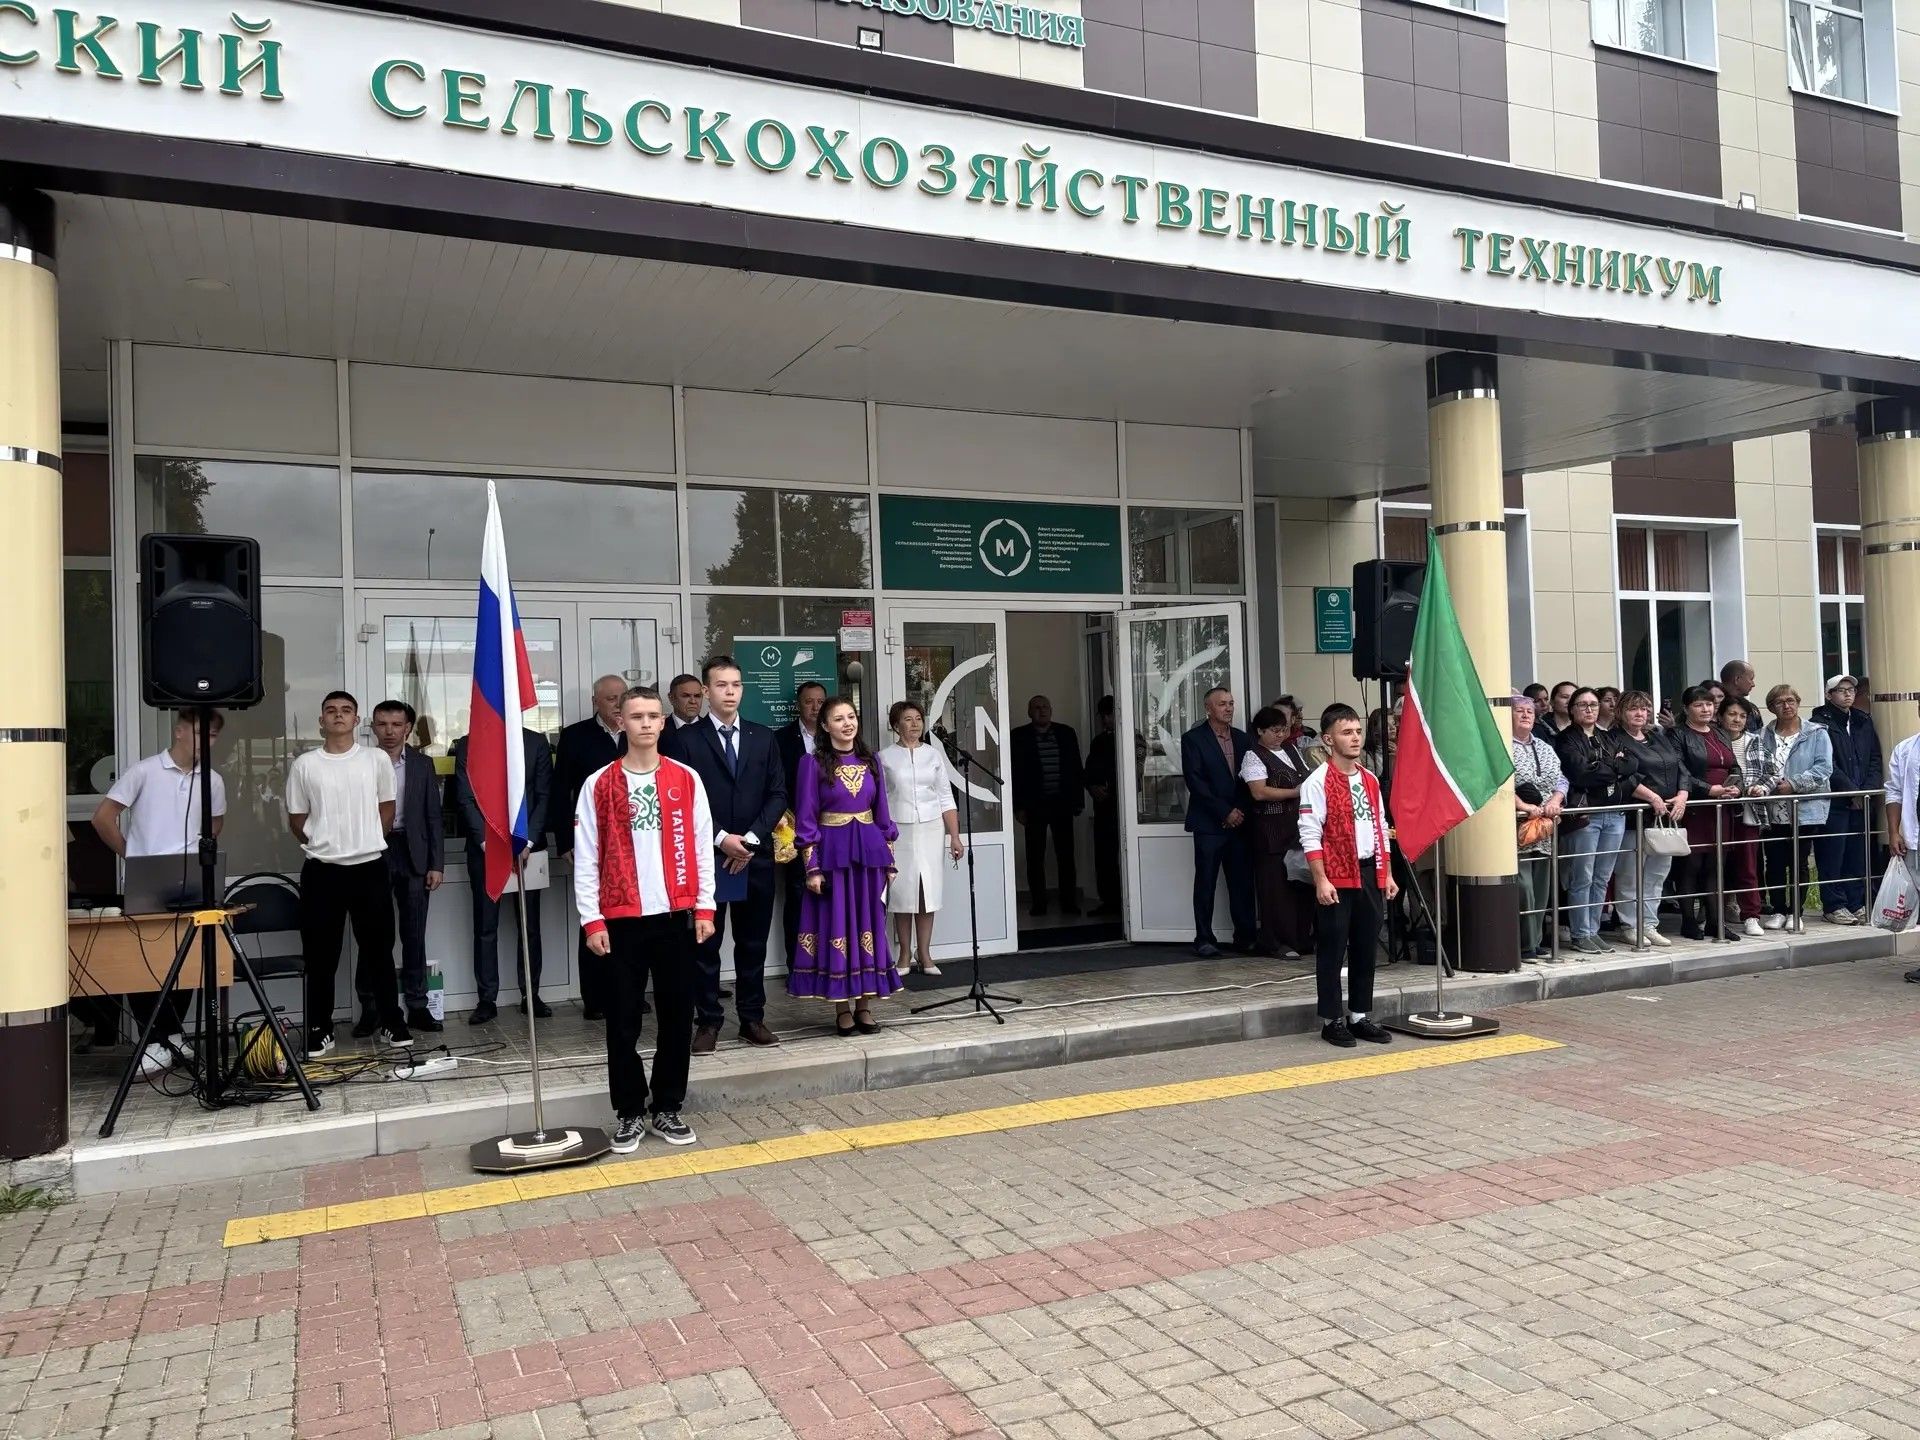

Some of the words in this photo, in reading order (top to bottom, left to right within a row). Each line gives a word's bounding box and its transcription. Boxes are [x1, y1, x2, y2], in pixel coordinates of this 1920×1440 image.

[0, 0, 285, 100] СКИЙ
[370, 58, 1412, 262] СЕЛЬСКОХОЗЯЙСТВЕННЫЙ
[1453, 226, 1723, 305] ТЕХНИКУМ
[671, 808, 687, 886] ТАТАРСТАН
